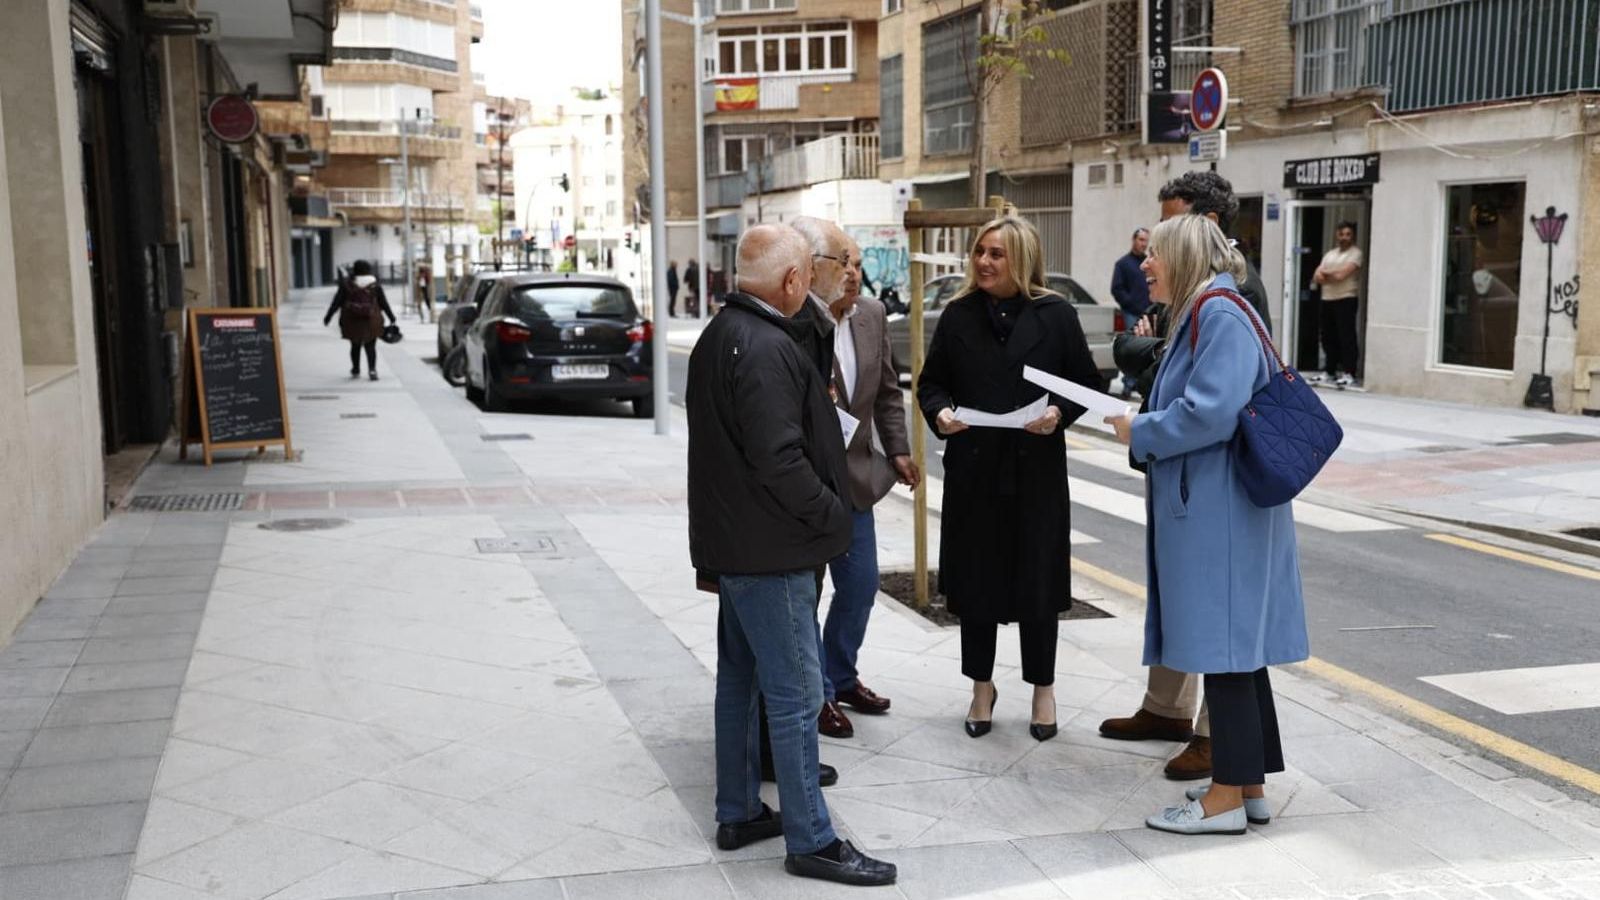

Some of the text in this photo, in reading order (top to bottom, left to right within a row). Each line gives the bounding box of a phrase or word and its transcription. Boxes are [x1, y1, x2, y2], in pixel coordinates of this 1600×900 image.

[1296, 158, 1365, 184] CLUB DE BOXEO
